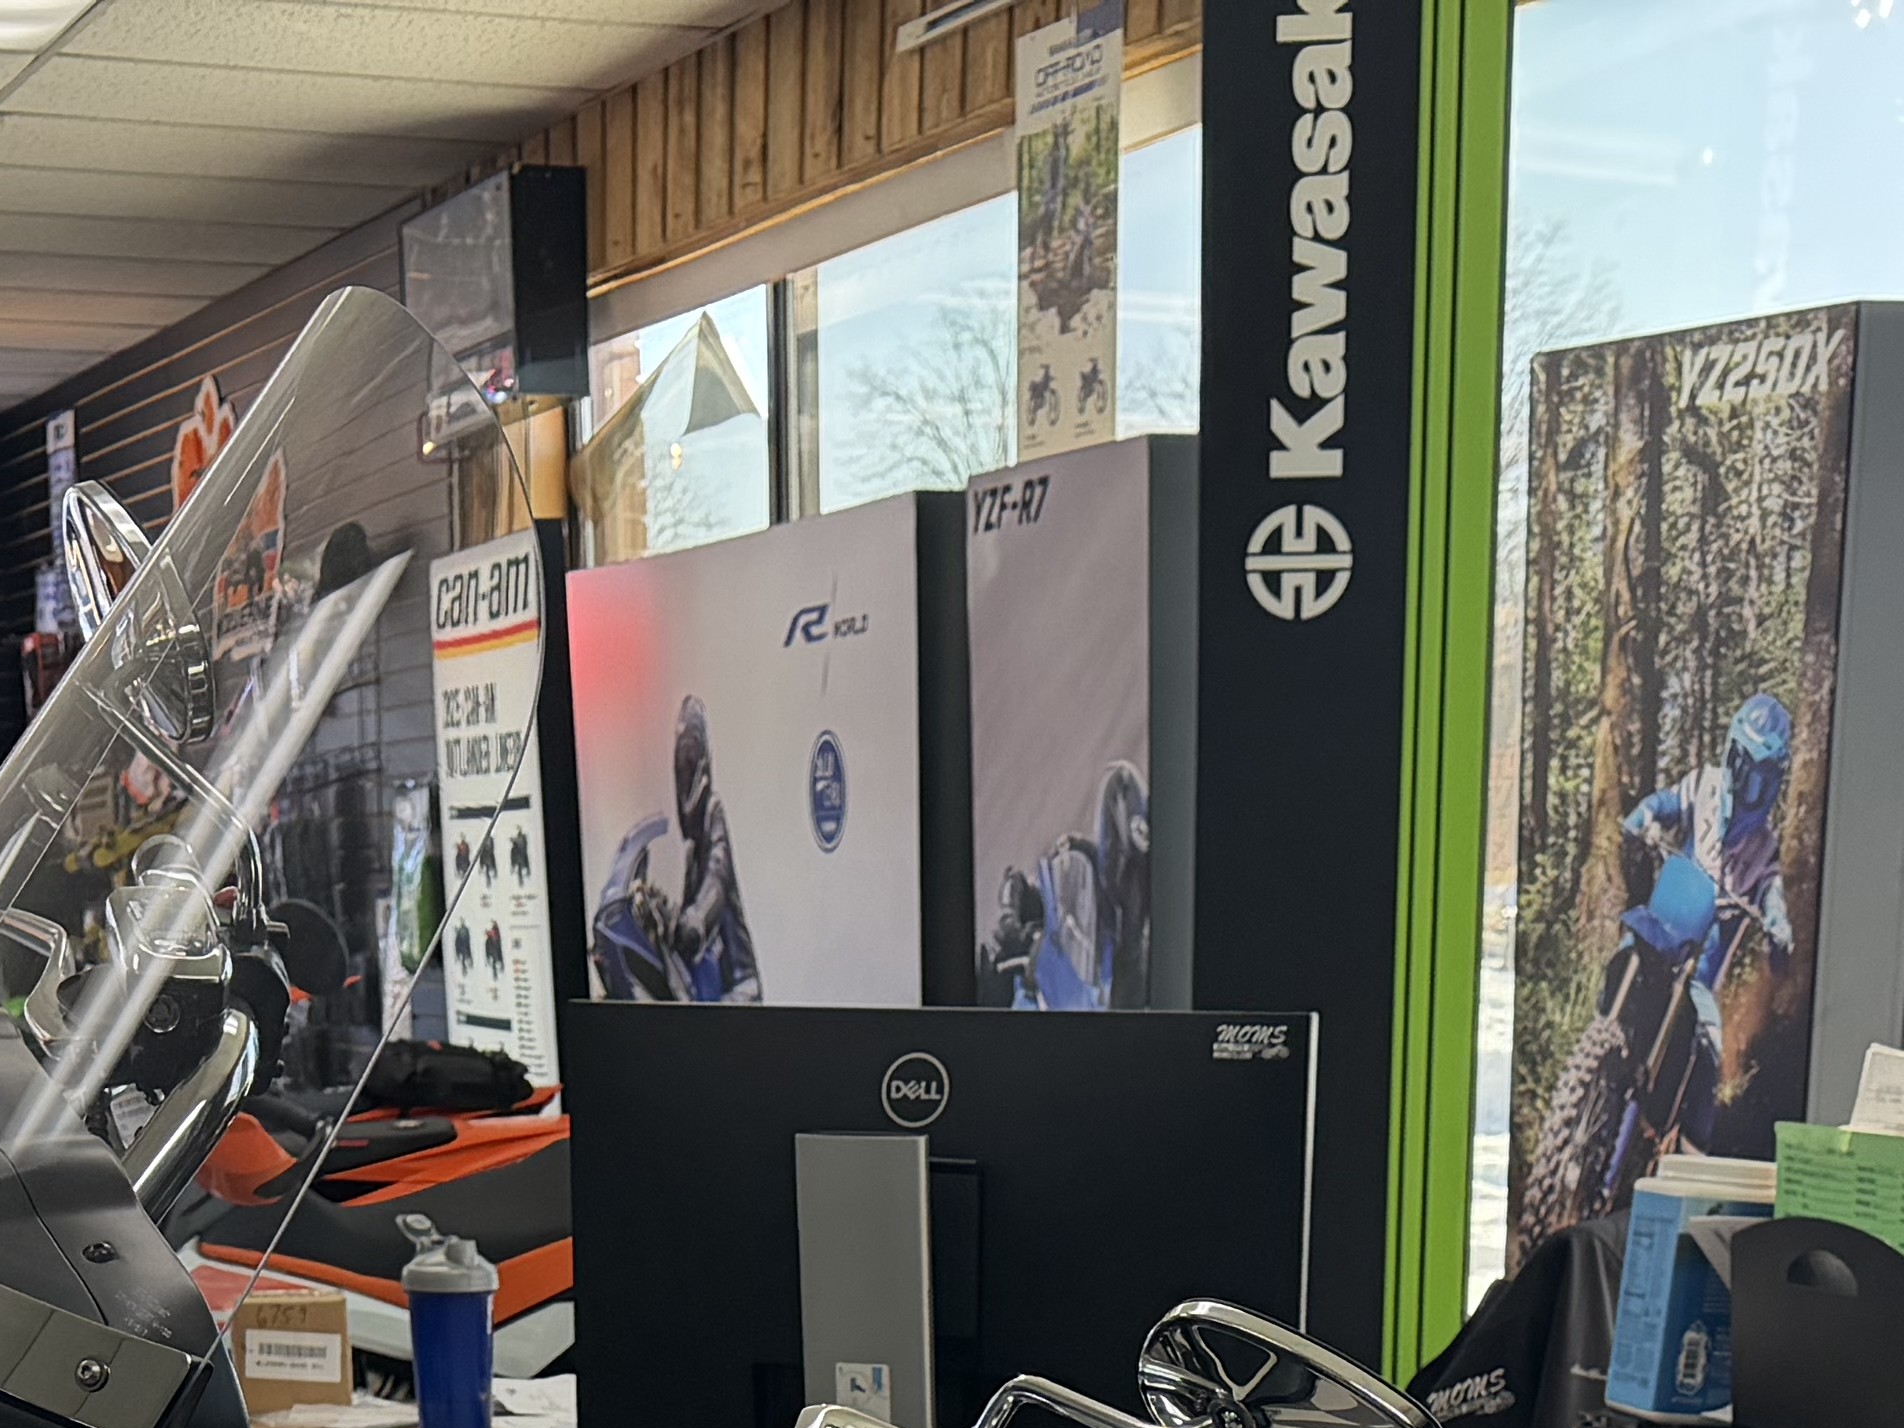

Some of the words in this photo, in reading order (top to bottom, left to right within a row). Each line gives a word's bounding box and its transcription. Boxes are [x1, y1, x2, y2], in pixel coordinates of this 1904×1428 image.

[1677, 328, 1846, 410] YZ250X
[973, 475, 1050, 535] YZF-R7
[435, 552, 530, 630] can-am
[889, 1079, 942, 1100] DELL
